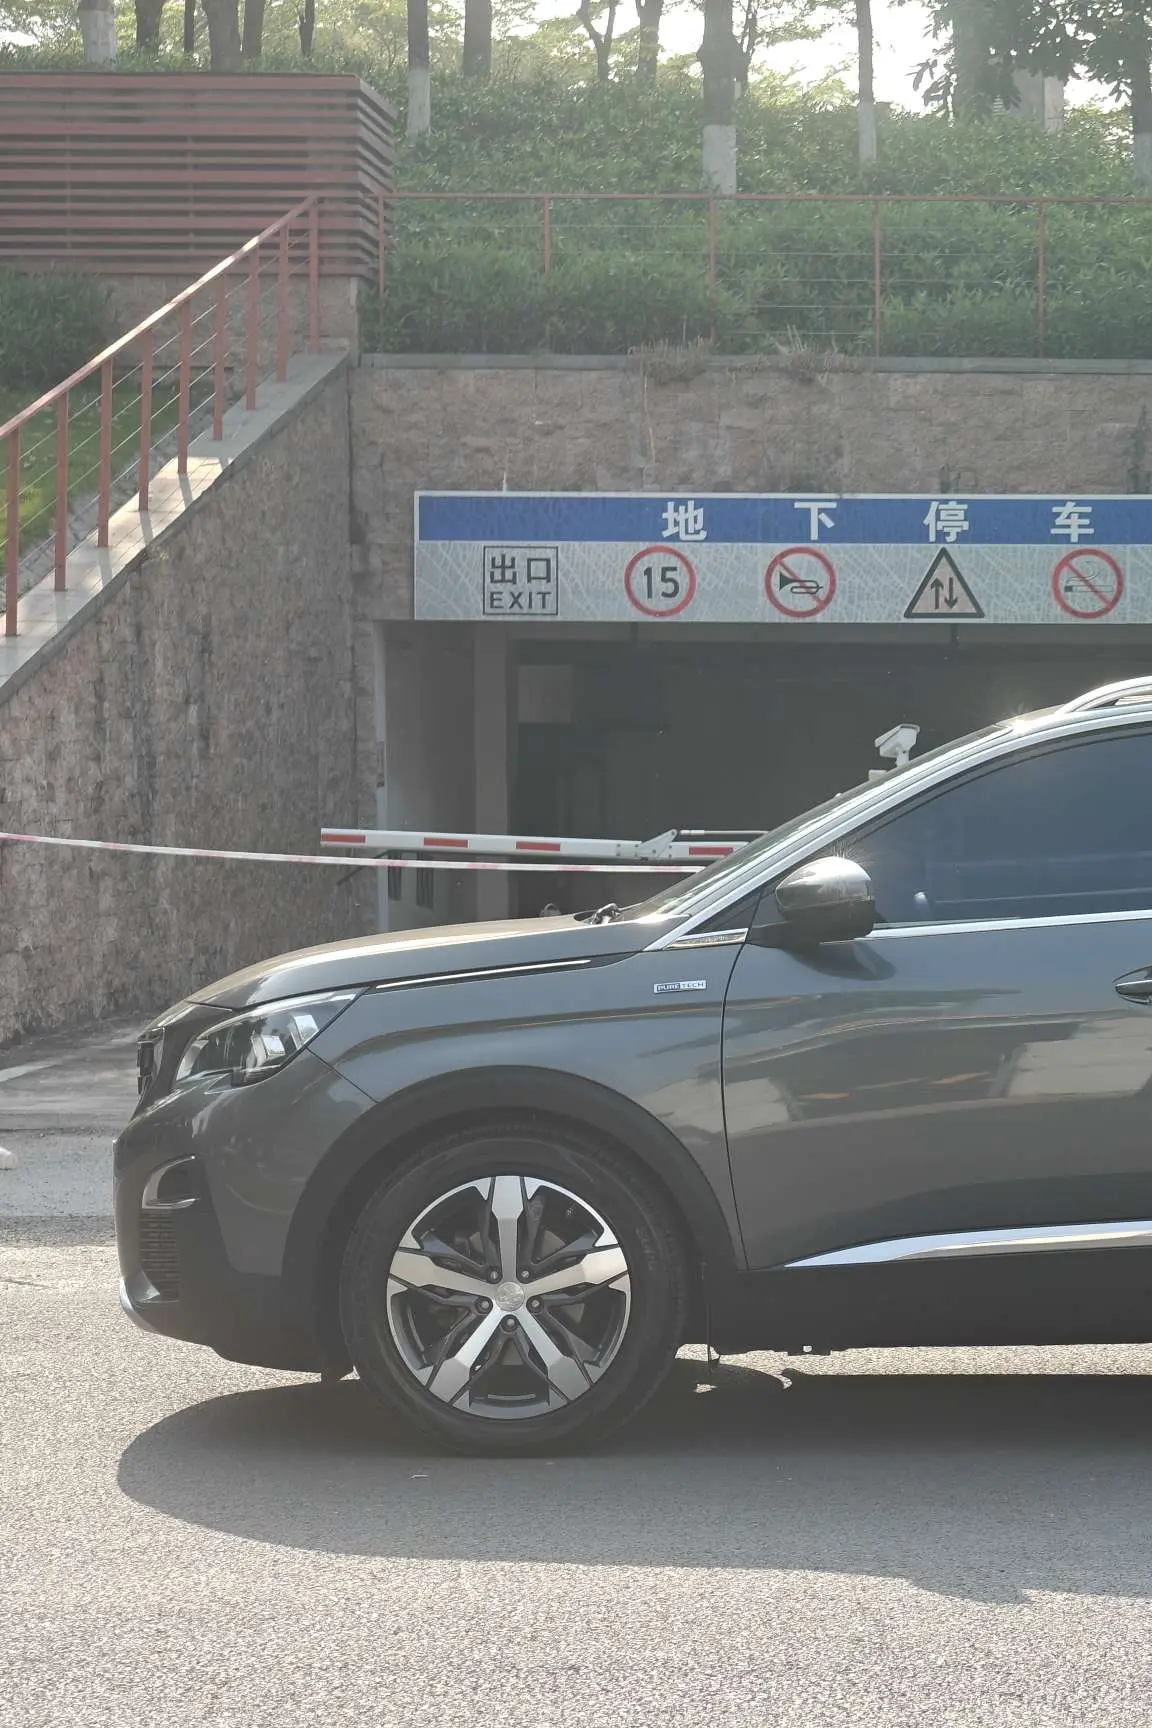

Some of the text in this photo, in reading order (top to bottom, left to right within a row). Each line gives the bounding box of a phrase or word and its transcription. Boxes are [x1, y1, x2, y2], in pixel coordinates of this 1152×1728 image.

[489, 554, 552, 586] 出口
[643, 566, 680, 600] 15
[489, 591, 552, 610] EXIT
